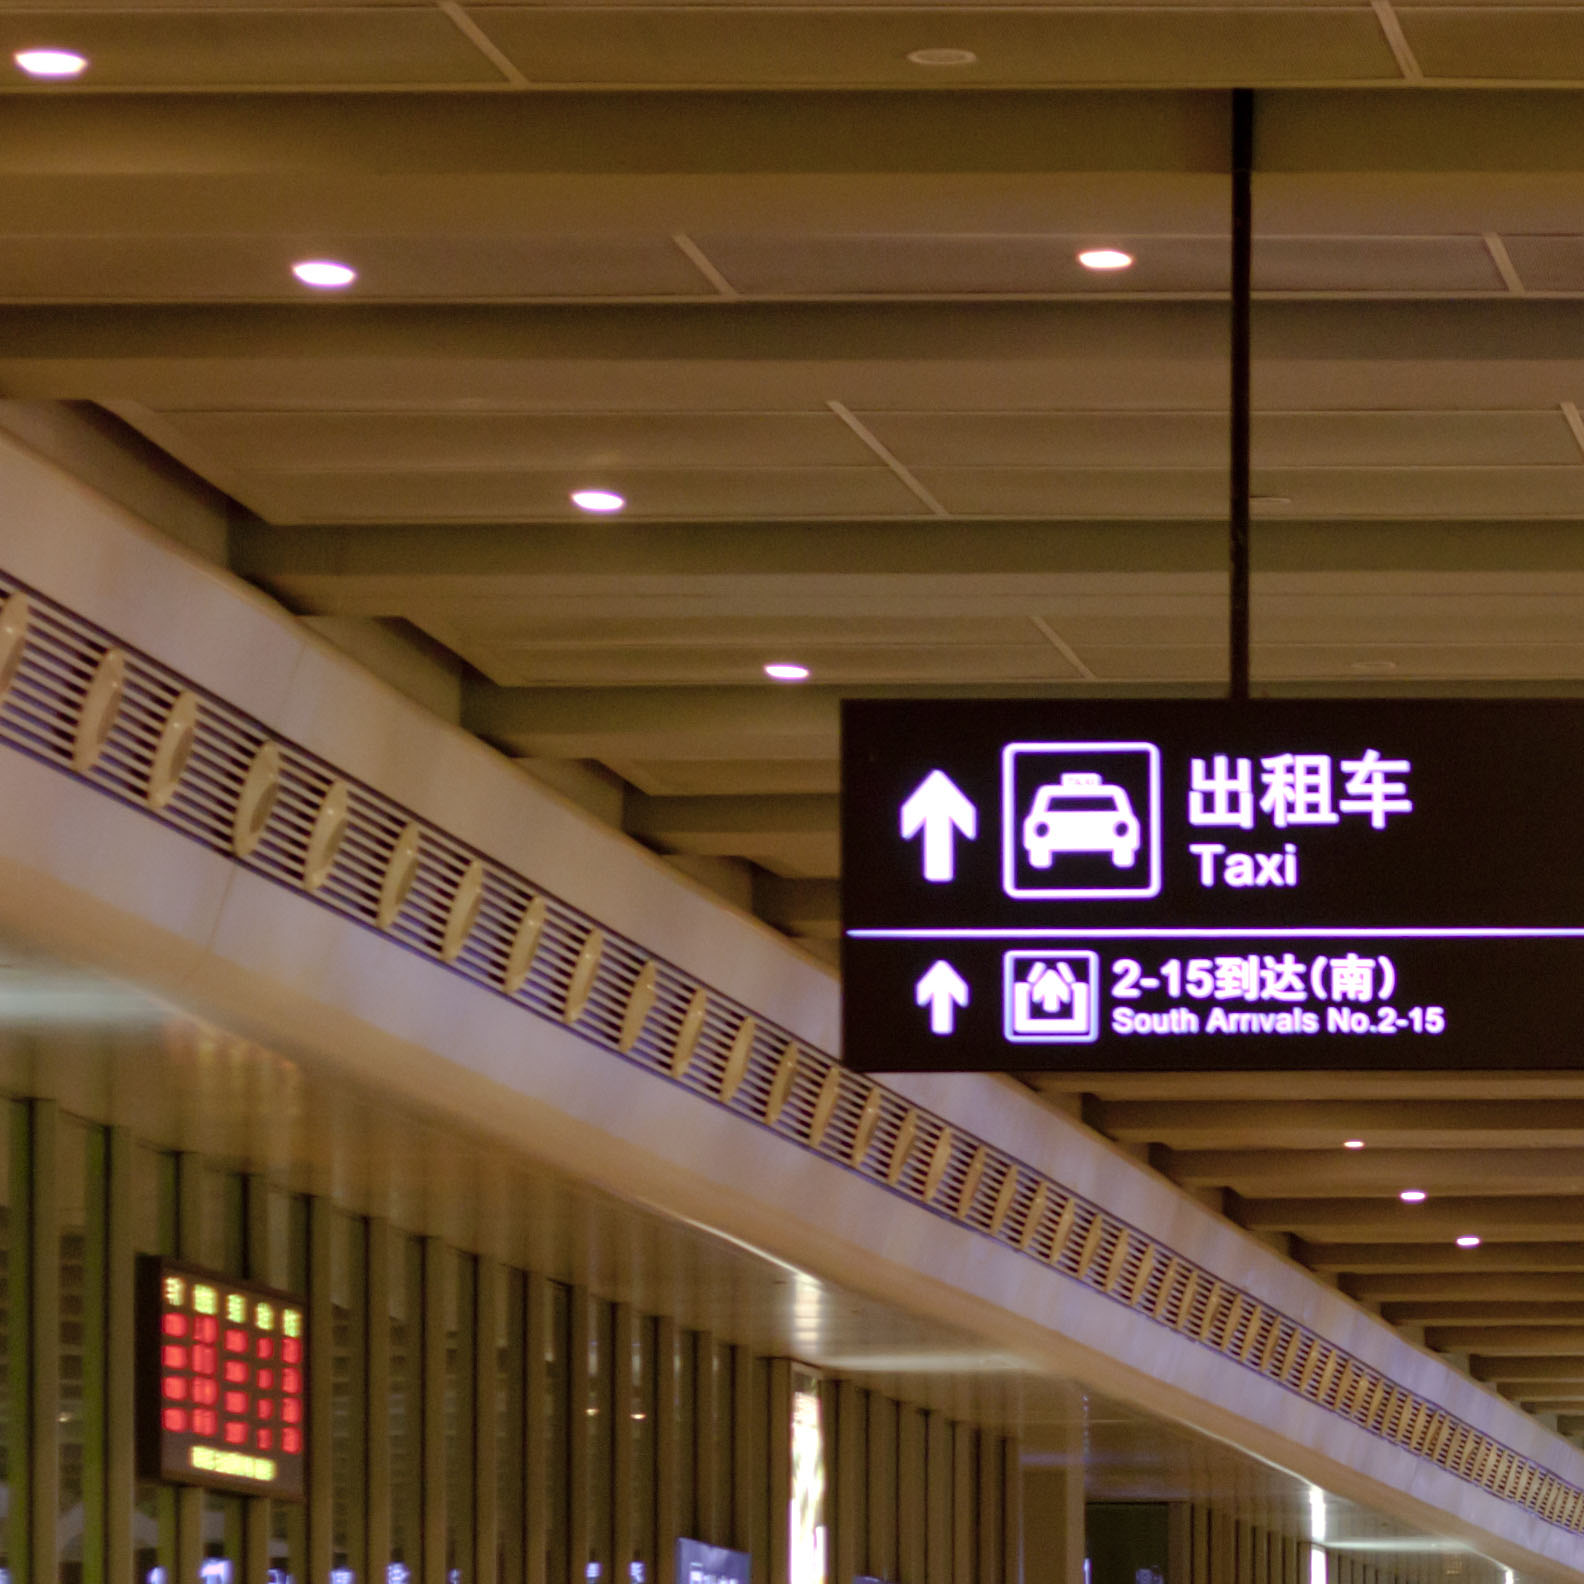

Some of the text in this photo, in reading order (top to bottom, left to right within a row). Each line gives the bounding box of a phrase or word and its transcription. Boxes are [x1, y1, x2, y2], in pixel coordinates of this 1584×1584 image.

[1190, 750, 1411, 828] 出租车
[1190, 844, 1296, 886] Taxi
[1112, 953, 1394, 1001] 2-15到达(南)
[1113, 1007, 1444, 1033] South Arrivals No.2-15
